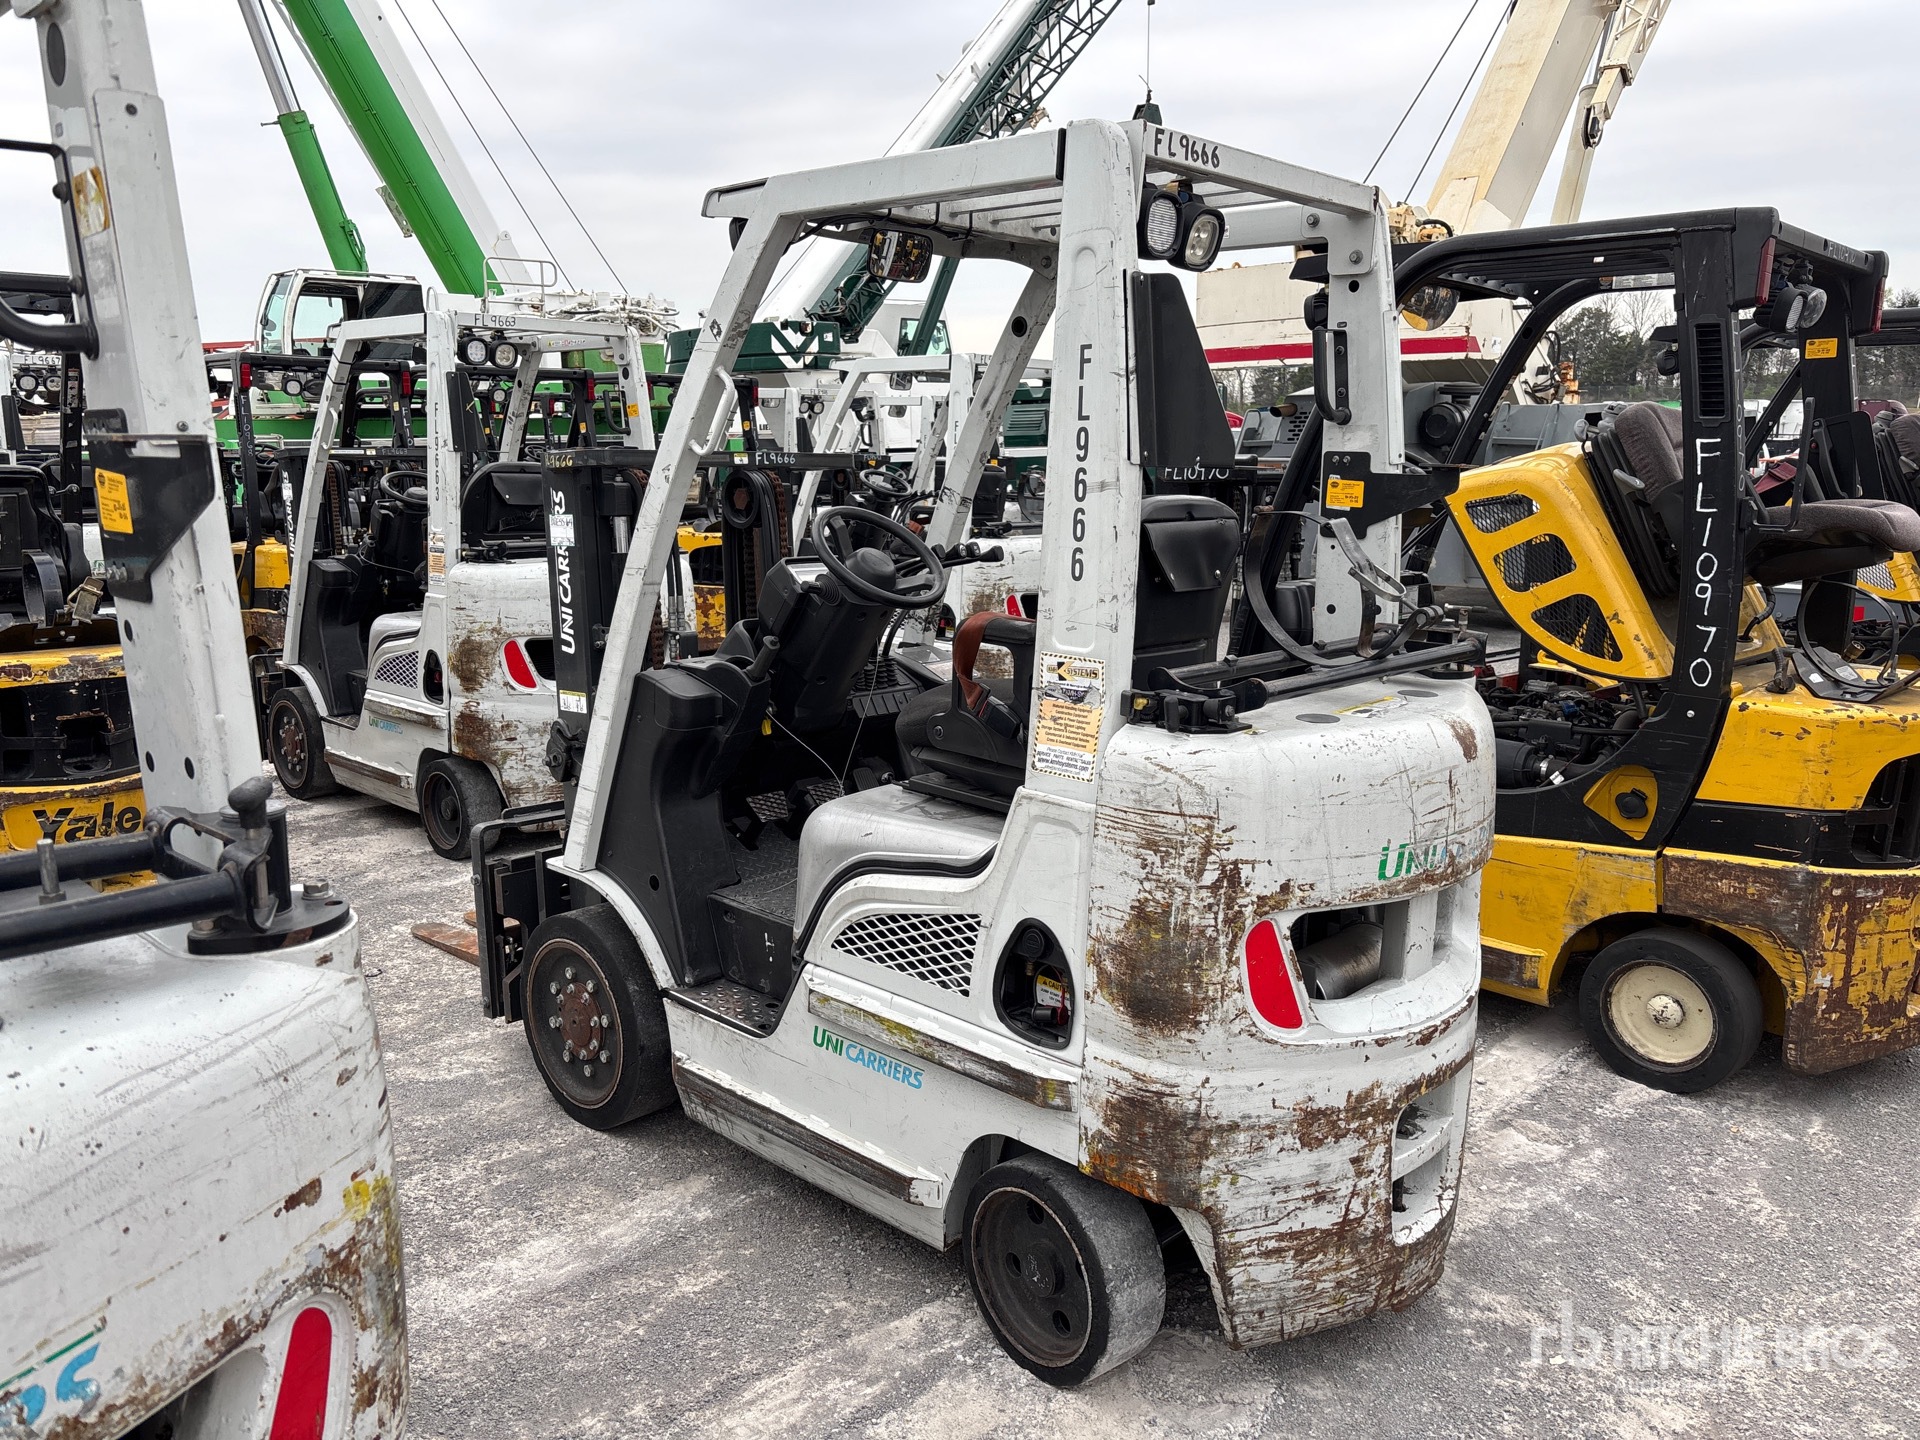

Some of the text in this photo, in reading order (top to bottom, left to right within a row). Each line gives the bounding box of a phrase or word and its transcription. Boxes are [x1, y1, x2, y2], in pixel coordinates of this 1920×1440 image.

[1154, 127, 1220, 168] FL9666
[474, 313, 516, 327] FL9663
[755, 452, 796, 466] FL9666
[1071, 343, 1092, 582] FL9666
[1689, 438, 1722, 687] FL10970
[33, 801, 142, 844] Yale
